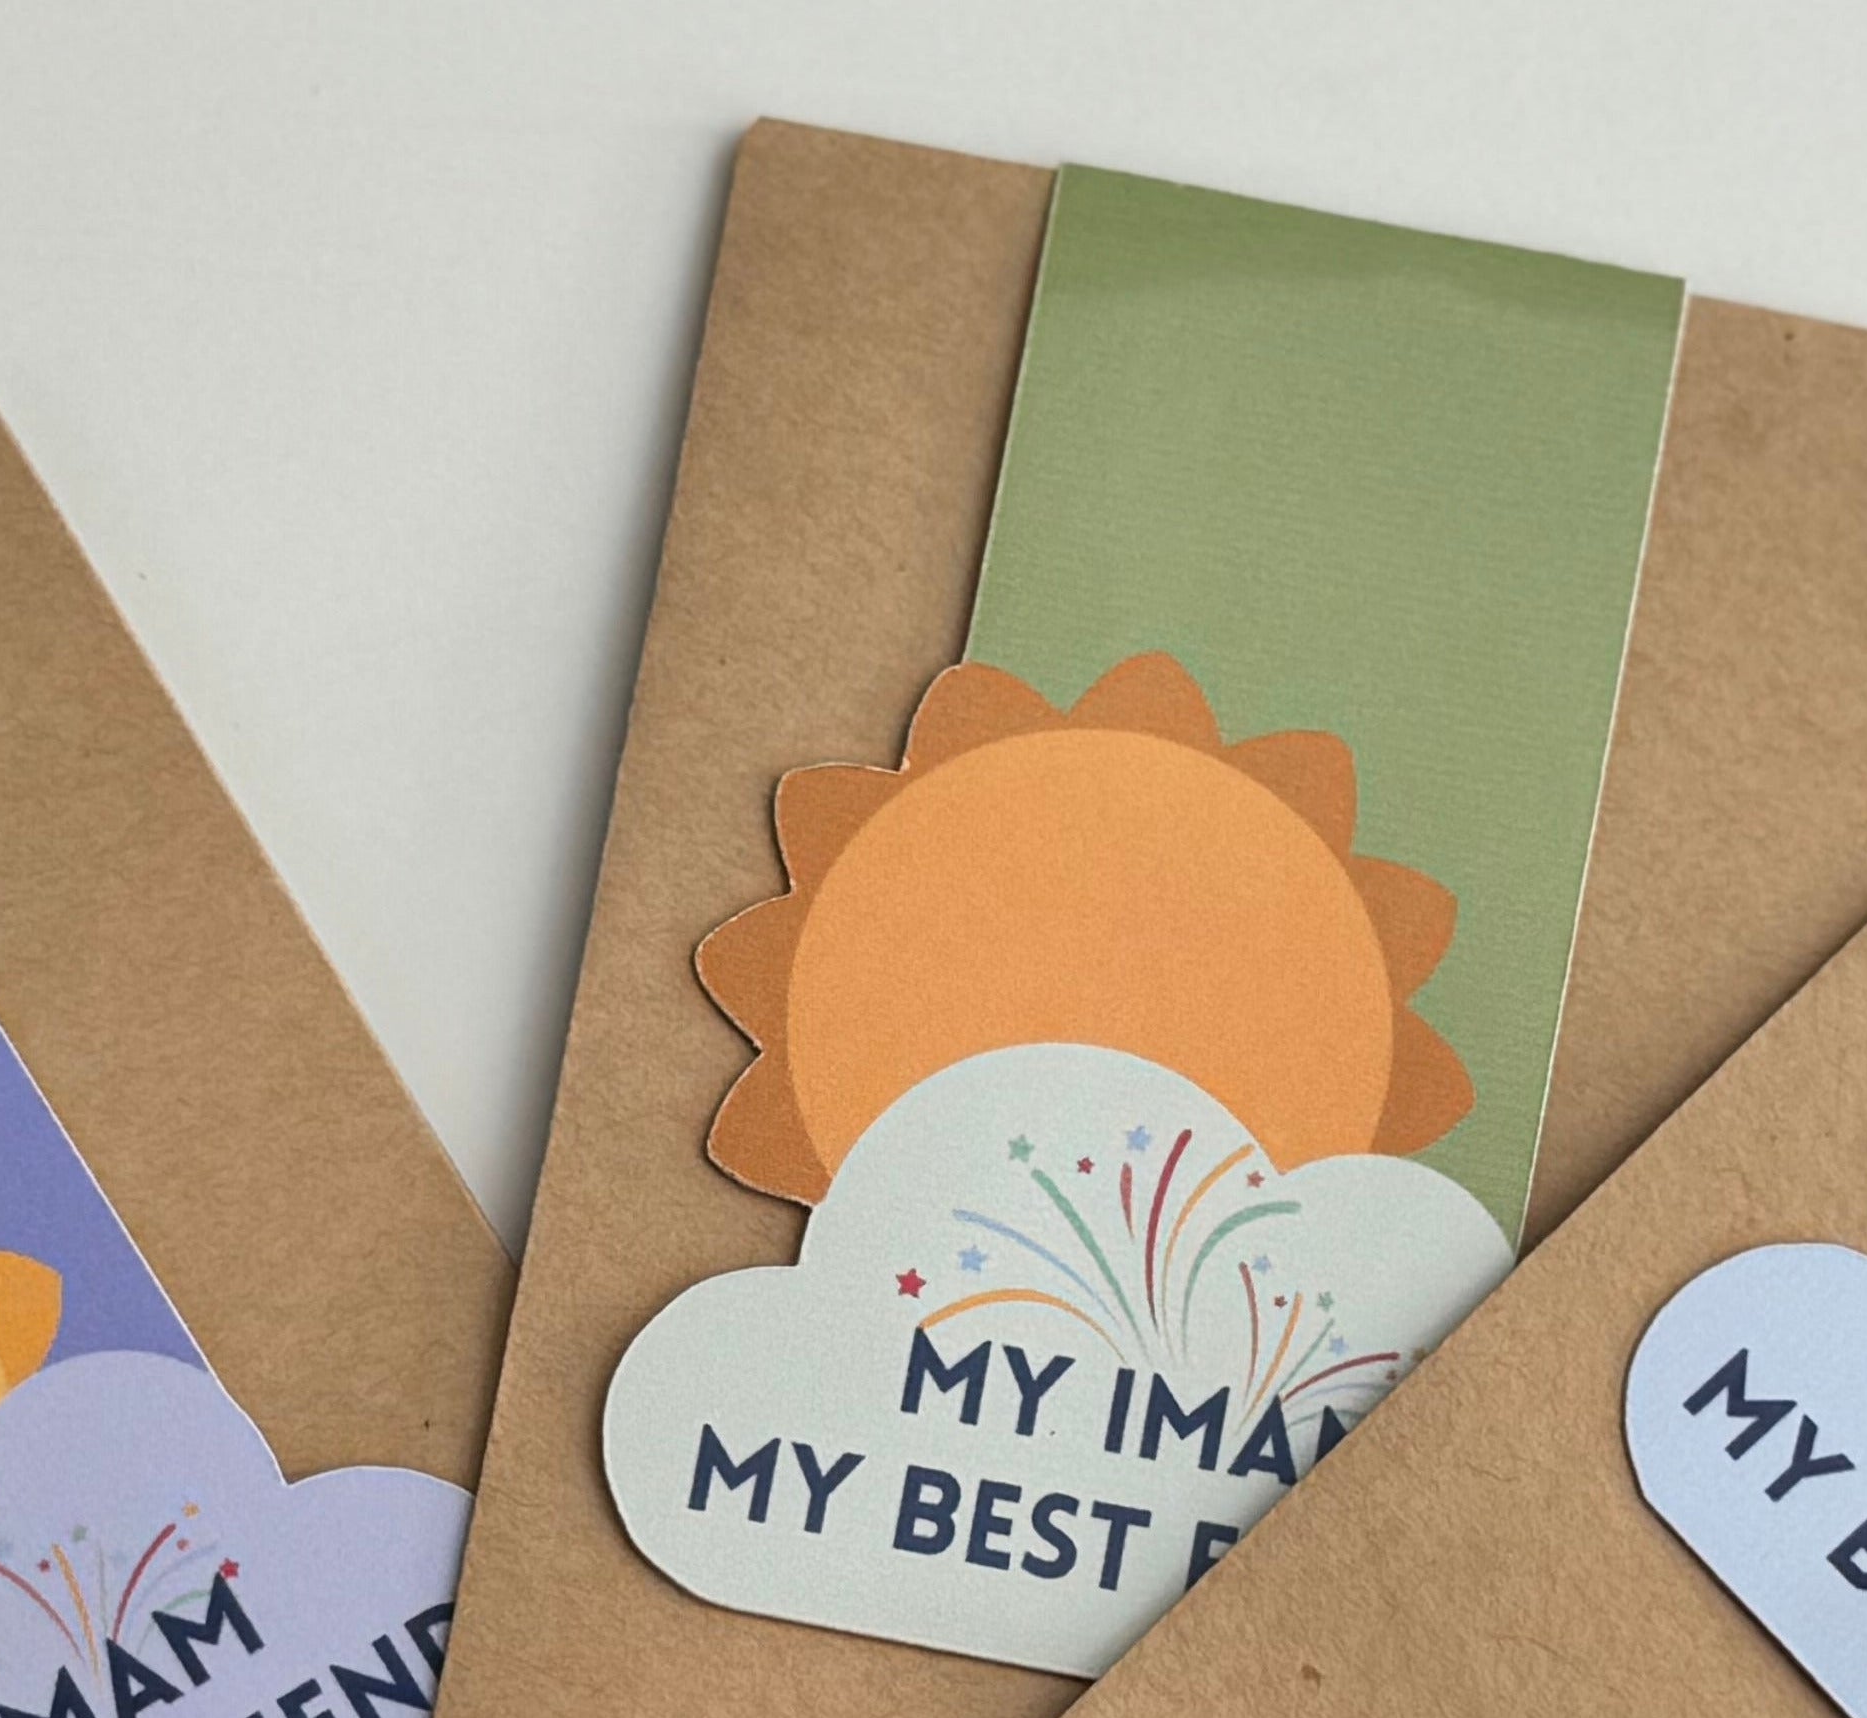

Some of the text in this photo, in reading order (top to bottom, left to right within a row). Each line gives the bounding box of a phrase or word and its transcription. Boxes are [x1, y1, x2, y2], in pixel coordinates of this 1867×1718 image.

[899, 1326, 1076, 1438] MY
[1682, 1347, 1856, 1503] MY
[687, 1423, 865, 1535] MY
[892, 1465, 1152, 1592] BEST
